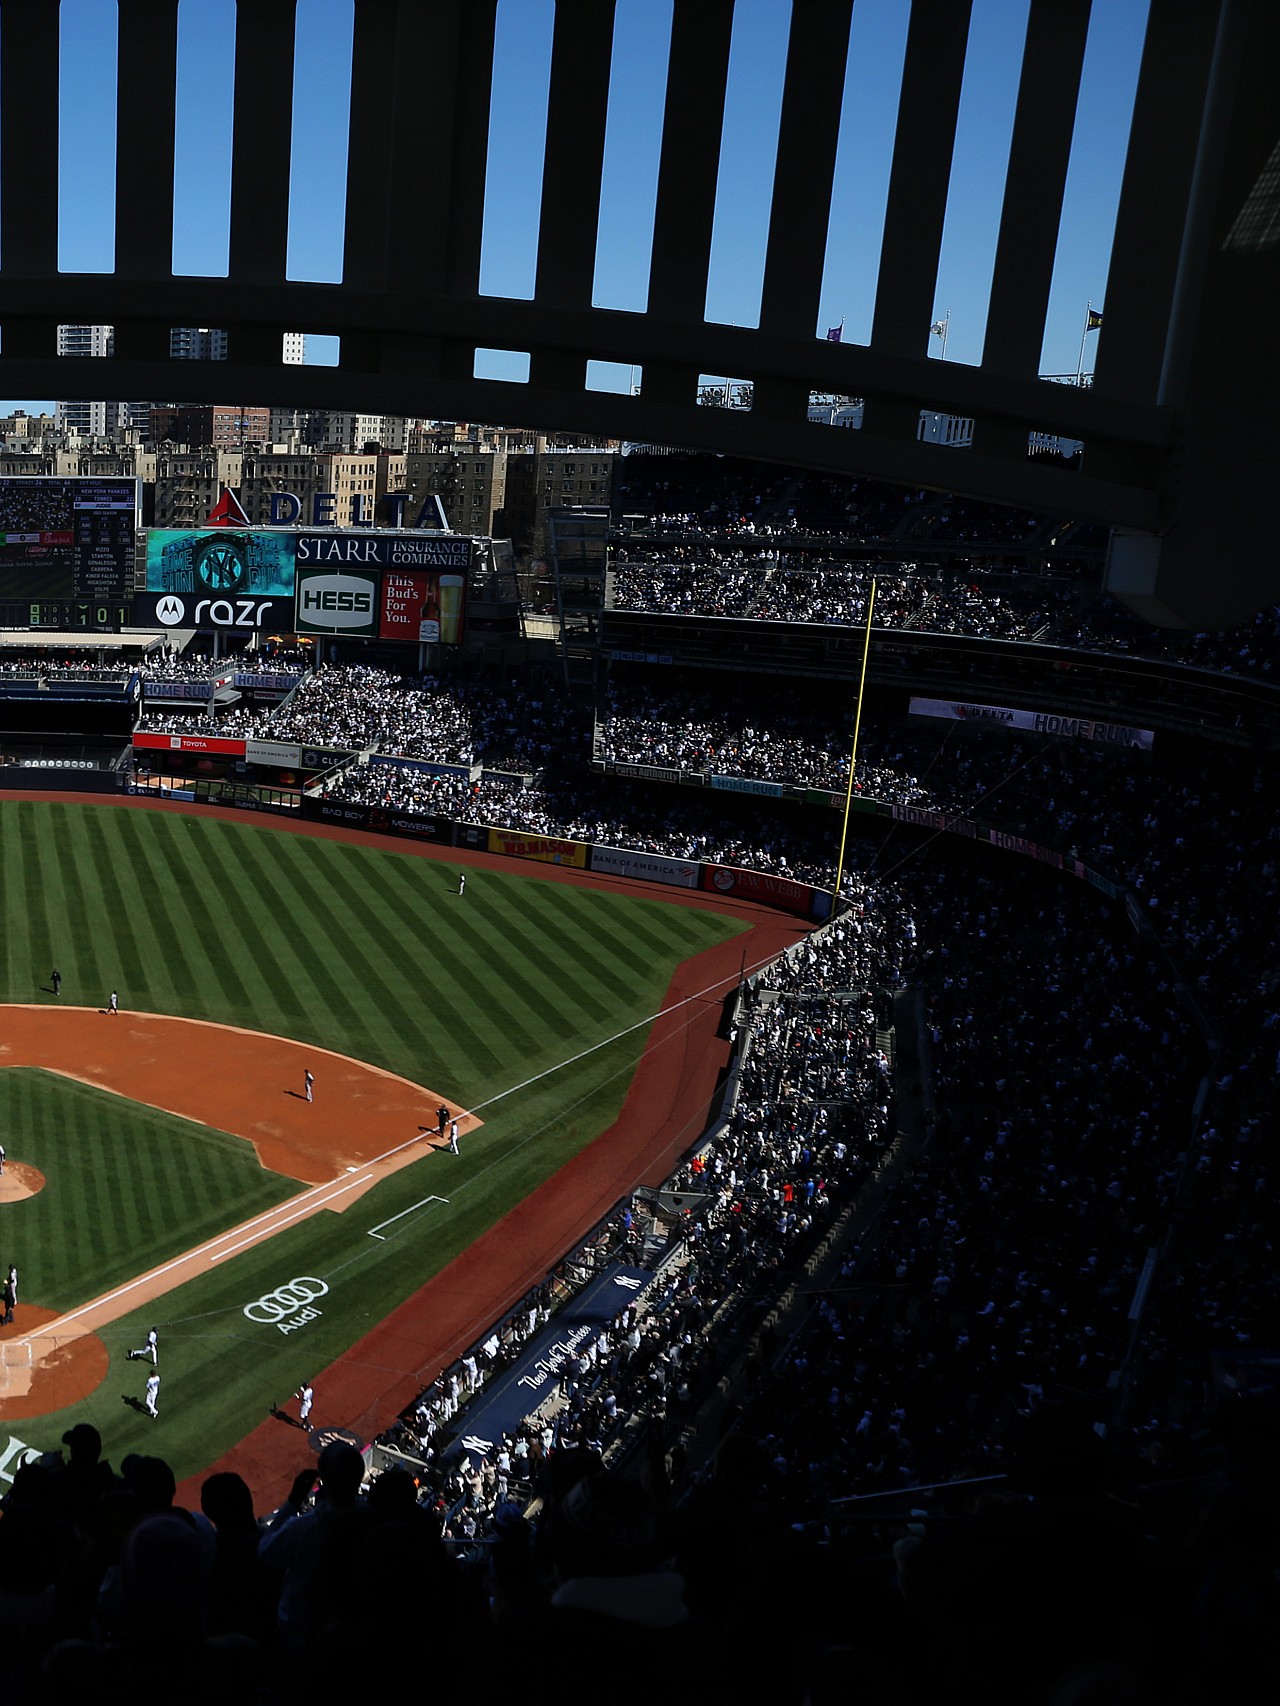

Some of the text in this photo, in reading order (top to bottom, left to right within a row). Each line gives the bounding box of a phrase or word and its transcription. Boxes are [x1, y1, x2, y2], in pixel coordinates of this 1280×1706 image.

[271, 492, 450, 530] DELTA
[297, 537, 382, 563] STARR
[393, 540, 468, 555] INSURANCE
[392, 552, 468, 566] COMPANIES
[386, 574, 414, 587] This
[303, 589, 371, 612] HESS
[386, 586, 419, 599] Bud's
[97, 607, 107, 622] 0
[118, 608, 124, 623] 1
[195, 600, 273, 627] razr
[386, 599, 406, 611] For
[385, 611, 410, 623] You.
[238, 675, 271, 687] HOME
[145, 685, 210, 698] HOME RUN
[971, 708, 1134, 746] DELTA HOME RUN
[616, 764, 678, 781] Parts Authority
[717, 776, 780, 796] HOME RUN
[322, 807, 436, 833] BAD BOY MOWERS
[593, 854, 675, 875] BANK OF AMERICA
[736, 872, 762, 889] F.W.
[764, 879, 802, 899] WEBB
[277, 1305, 323, 1336] Audi
[518, 1369, 548, 1390] New
[554, 1324, 592, 1360] Yankees
